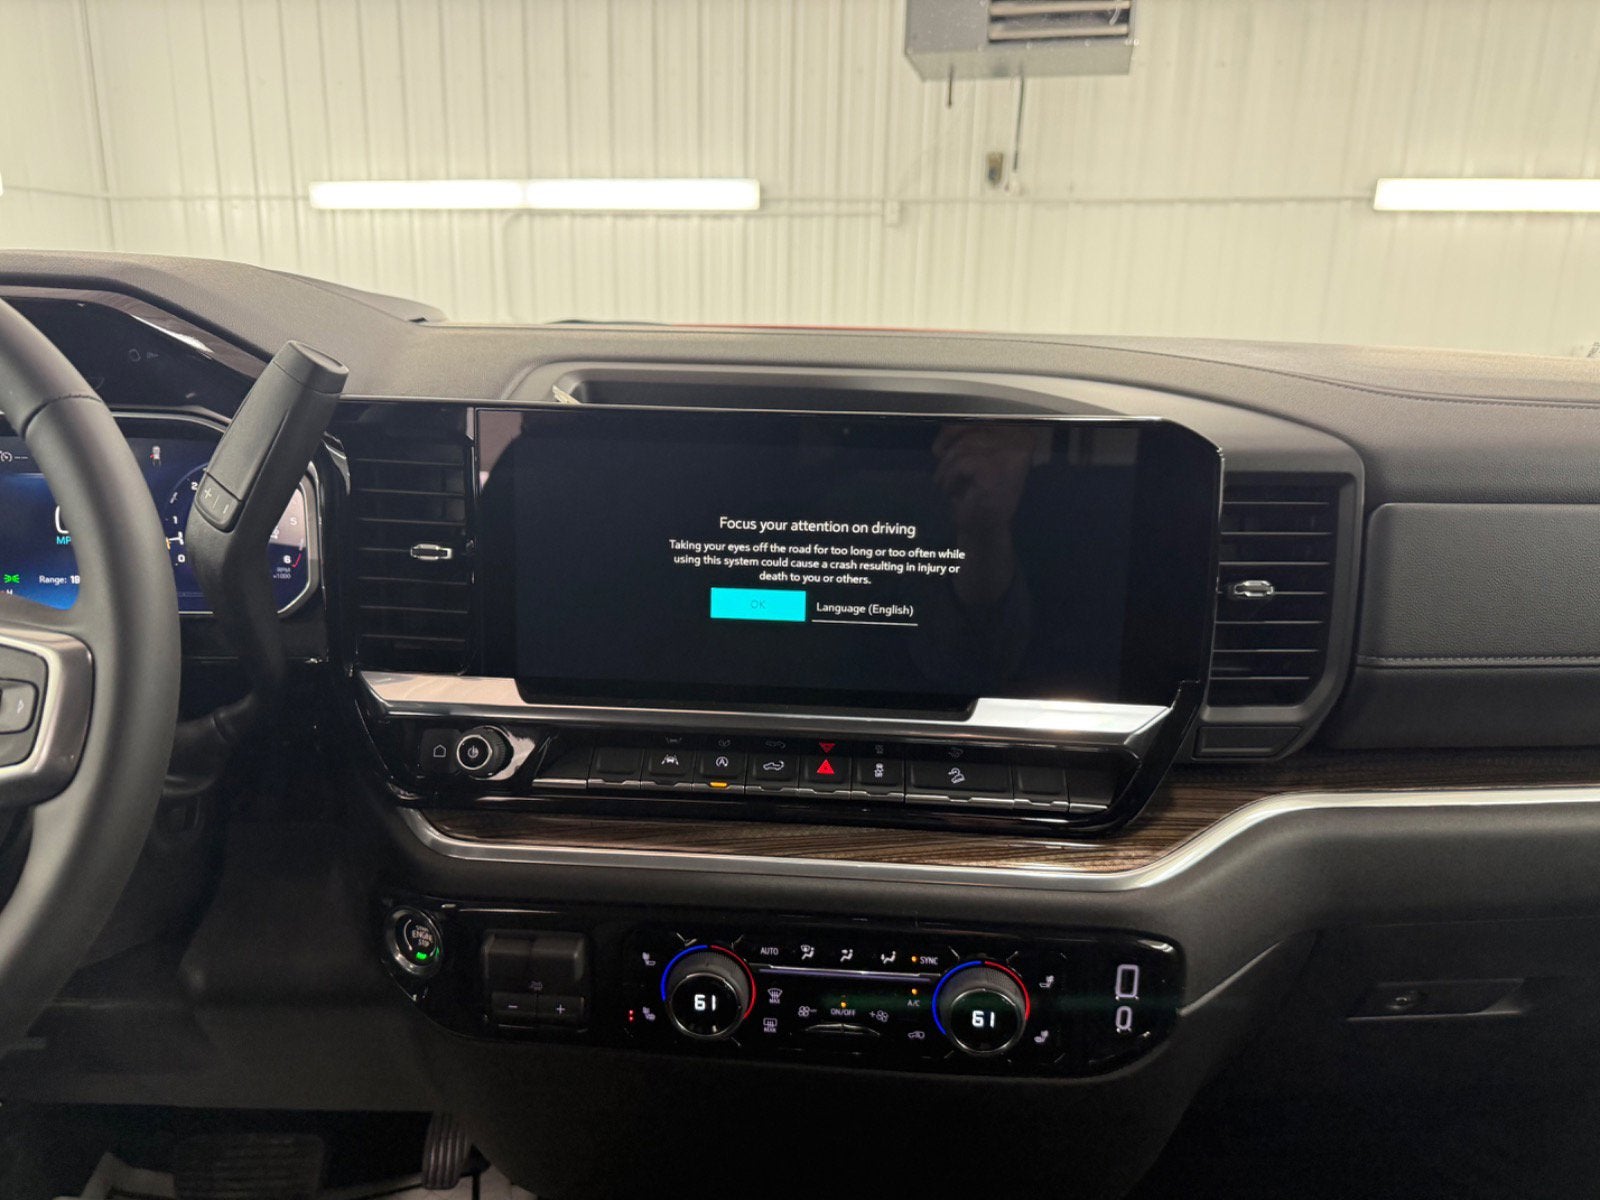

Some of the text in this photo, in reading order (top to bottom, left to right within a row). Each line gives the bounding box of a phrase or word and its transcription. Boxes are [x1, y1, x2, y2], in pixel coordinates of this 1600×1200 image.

[720, 515, 917, 539] Focus your attention on driving
[56, 536, 72, 545] MP
[669, 538, 966, 560] Taking your eyes off the road for too long or too often while
[674, 554, 961, 576] using this system could cause a crash resulting in injury or
[39, 575, 67, 586] Range:
[759, 570, 872, 585] death to you or others.
[750, 600, 765, 610] OK
[817, 601, 914, 618] Language (English)
[760, 947, 779, 956] AUTO
[919, 956, 939, 965] SYNC
[694, 994, 716, 1011] 61
[907, 1000, 921, 1008] A/C
[830, 1008, 856, 1017] ON/OFF
[972, 1010, 995, 1028] 61
